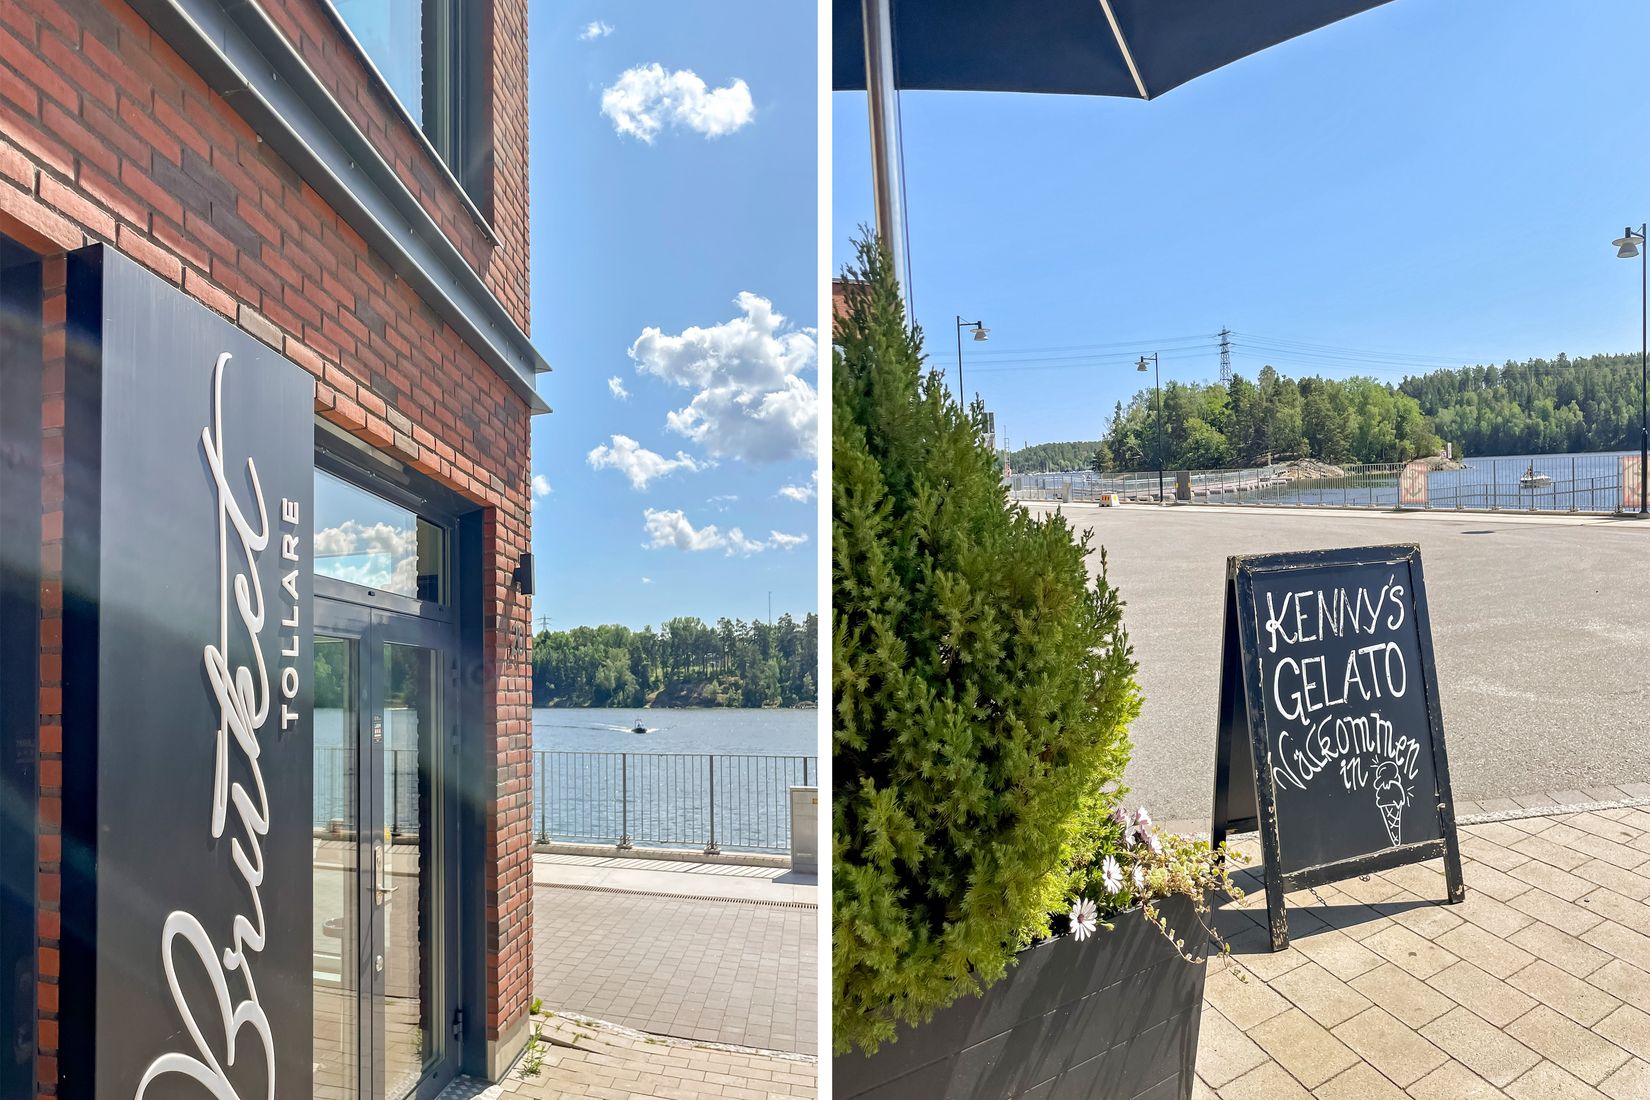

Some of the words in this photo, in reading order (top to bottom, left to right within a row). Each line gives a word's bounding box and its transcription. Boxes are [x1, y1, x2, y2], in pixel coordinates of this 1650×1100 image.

[281, 497, 300, 730] TOLLARE
[1265, 574, 1405, 653] KENNY'S
[1273, 641, 1407, 726] GELATO
[134, 352, 276, 1100] Bruket
[1273, 713, 1420, 790] Välkommen
[1339, 756, 1369, 791] in
